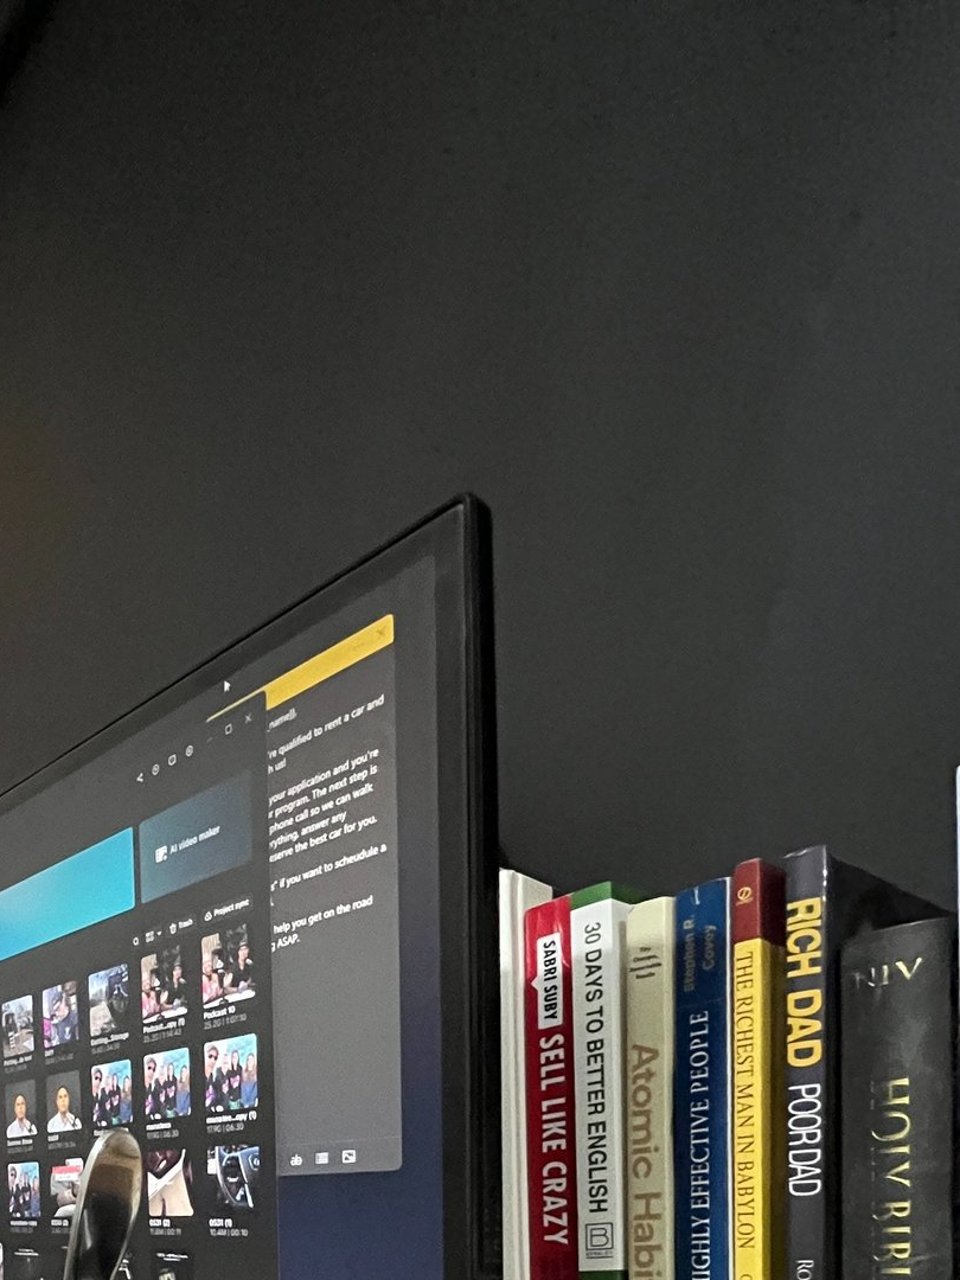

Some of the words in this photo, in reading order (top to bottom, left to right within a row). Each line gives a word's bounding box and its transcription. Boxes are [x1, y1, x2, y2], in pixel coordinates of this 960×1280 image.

[278, 730, 312, 756] qualified
[313, 727, 323, 737] to
[324, 716, 342, 732] rent
[343, 714, 350, 722] a
[351, 705, 365, 719] car
[366, 693, 385, 711] and
[269, 791, 287, 808] your
[287, 770, 331, 796] application
[333, 760, 349, 776] and
[350, 749, 379, 770] you're
[274, 796, 311, 818] program.
[312, 787, 327, 800] The
[328, 777, 347, 793] next
[349, 770, 368, 785] step
[370, 764, 378, 775] is
[269, 817, 294, 836] phone
[295, 809, 309, 822] call
[310, 807, 320, 817] so
[321, 800, 334, 811] we
[335, 793, 351, 806] can
[352, 782, 374, 799] walk
[294, 842, 308, 853] the
[309, 833, 328, 847] best
[328, 828, 342, 840] car
[343, 822, 357, 834] for
[358, 815, 378, 832] you.
[301, 818, 330, 836] answer
[331, 811, 347, 824] any
[178, 836, 198, 850] video
[198, 825, 221, 841] maker
[279, 877, 285, 888] if
[286, 874, 302, 889] you
[302, 865, 322, 880] want
[324, 862, 333, 872] to
[380, 843, 388, 853] a
[213, 903, 235, 917] Project
[273, 921, 291, 934] help
[291, 918, 307, 931] you
[308, 911, 322, 927] get
[323, 909, 335, 919] on
[336, 904, 351, 915] the
[352, 894, 374, 910] road
[585, 922, 602, 945] 30
[786, 896, 822, 978] RICH
[277, 933, 300, 949] ASAP.
[543, 940, 557, 982] SABRI
[585, 949, 603, 1003] DAYS
[736, 951, 754, 993] THE
[851, 957, 923, 989] NIV
[543, 984, 558, 1021] SUBY
[586, 1005, 605, 1034] TO
[786, 988, 823, 1068] DAD
[539, 1033, 566, 1091] SELL
[690, 1010, 709, 1093] PEOPLE
[736, 996, 755, 1078] RICHEST
[586, 1038, 606, 1116] BETTER
[541, 1097, 567, 1153] LIKE
[631, 1044, 660, 1180] Atomic
[736, 1084, 755, 1128] MAN
[787, 1083, 822, 1146] POOR
[869, 1077, 911, 1187] HOLY
[587, 1121, 608, 1213] ENGLISH
[690, 1098, 710, 1209] EFFECTIVE
[737, 1134, 755, 1154] IN
[788, 1149, 822, 1197] DAD
[542, 1161, 569, 1245] CRAZY
[737, 1161, 756, 1250] BABYLON
